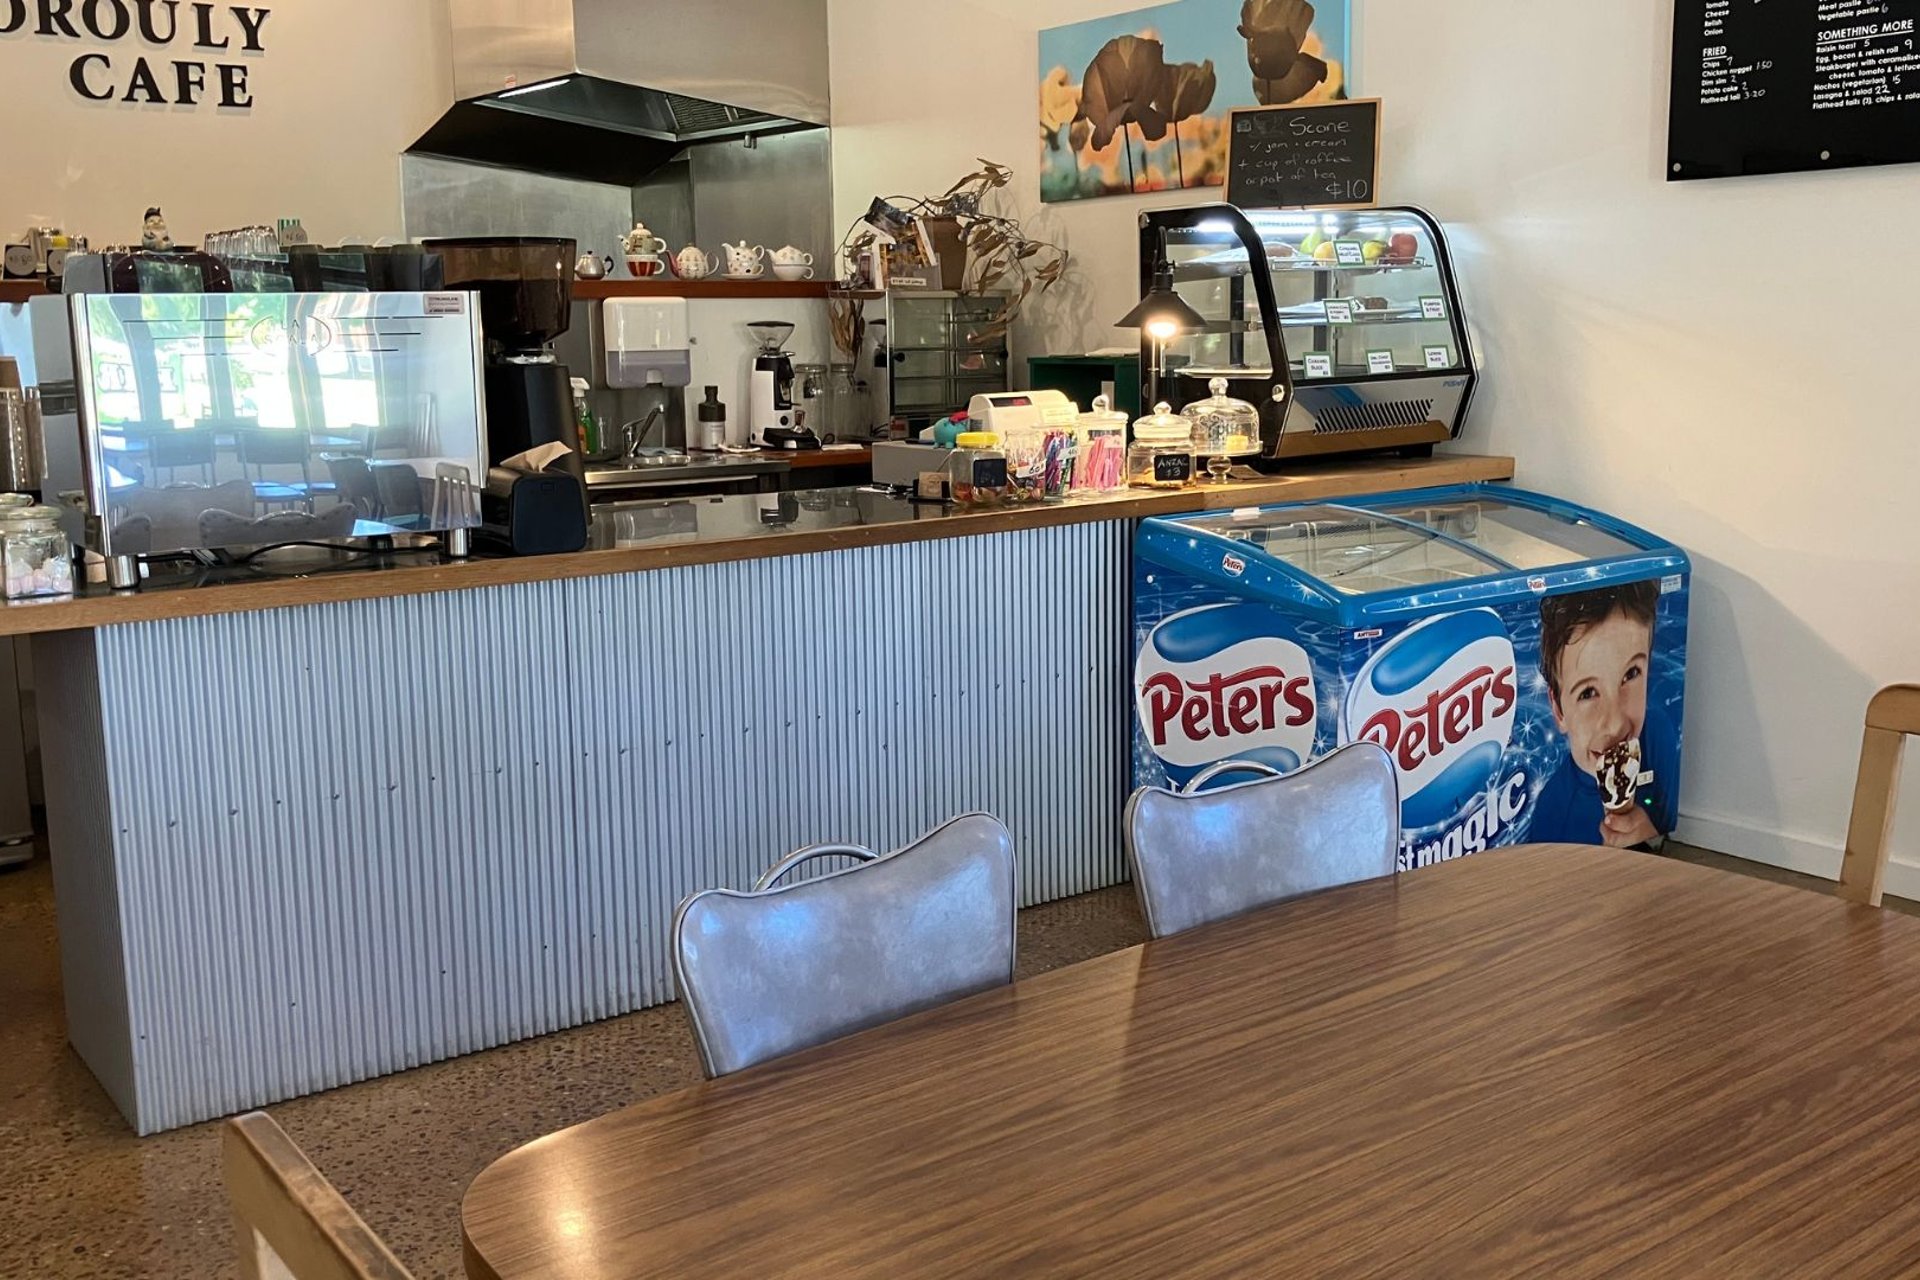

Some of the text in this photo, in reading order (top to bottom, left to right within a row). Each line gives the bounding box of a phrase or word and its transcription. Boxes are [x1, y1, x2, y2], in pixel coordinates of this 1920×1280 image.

[1705, 10, 1730, 18] Cheese
[1818, 3, 1838, 11] Meat
[1818, 3, 1889, 21] Vegetable pastie 6
[1817, 19, 1914, 41] SOMETHING MORE
[1703, 46, 1727, 57] FRIED
[1816, 39, 1870, 53] Raisin toast 5
[1833, 52, 1856, 61] bacon
[1865, 48, 1885, 56] relish
[1886, 46, 1899, 54] roll
[1904, 39, 1913, 50] 9
[1702, 69, 1728, 77] Chicken
[1729, 65, 1753, 74] nugget
[1815, 61, 1859, 72] Steakburger
[1861, 58, 1876, 66] with
[1858, 67, 1885, 76] tomato
[69, 53, 253, 108] CAFE
[1731, 75, 1738, 83] 2
[1742, 81, 1748, 90] 2
[1814, 74, 1901, 91] Nachos (vegetarian) 15
[1701, 95, 1729, 104] Flathead
[1730, 93, 1741, 101] tail
[1814, 91, 1843, 100] Lasagna
[1852, 88, 1873, 96] salad
[1875, 84, 1890, 94] 22
[1813, 100, 1844, 109] Flathead
[1845, 97, 1860, 106] tails
[1875, 95, 1895, 103] chips
[1905, 92, 1920, 100] sala
[1289, 116, 1351, 136] Scone
[1304, 139, 1347, 148] cream
[1255, 160, 1278, 170] cup
[1259, 172, 1283, 187] pot
[1290, 168, 1306, 181] of
[1325, 179, 1368, 199] $10
[1142, 666, 1314, 745] Peters
[1358, 666, 1515, 771] Peters
[1417, 771, 1527, 868] magic
